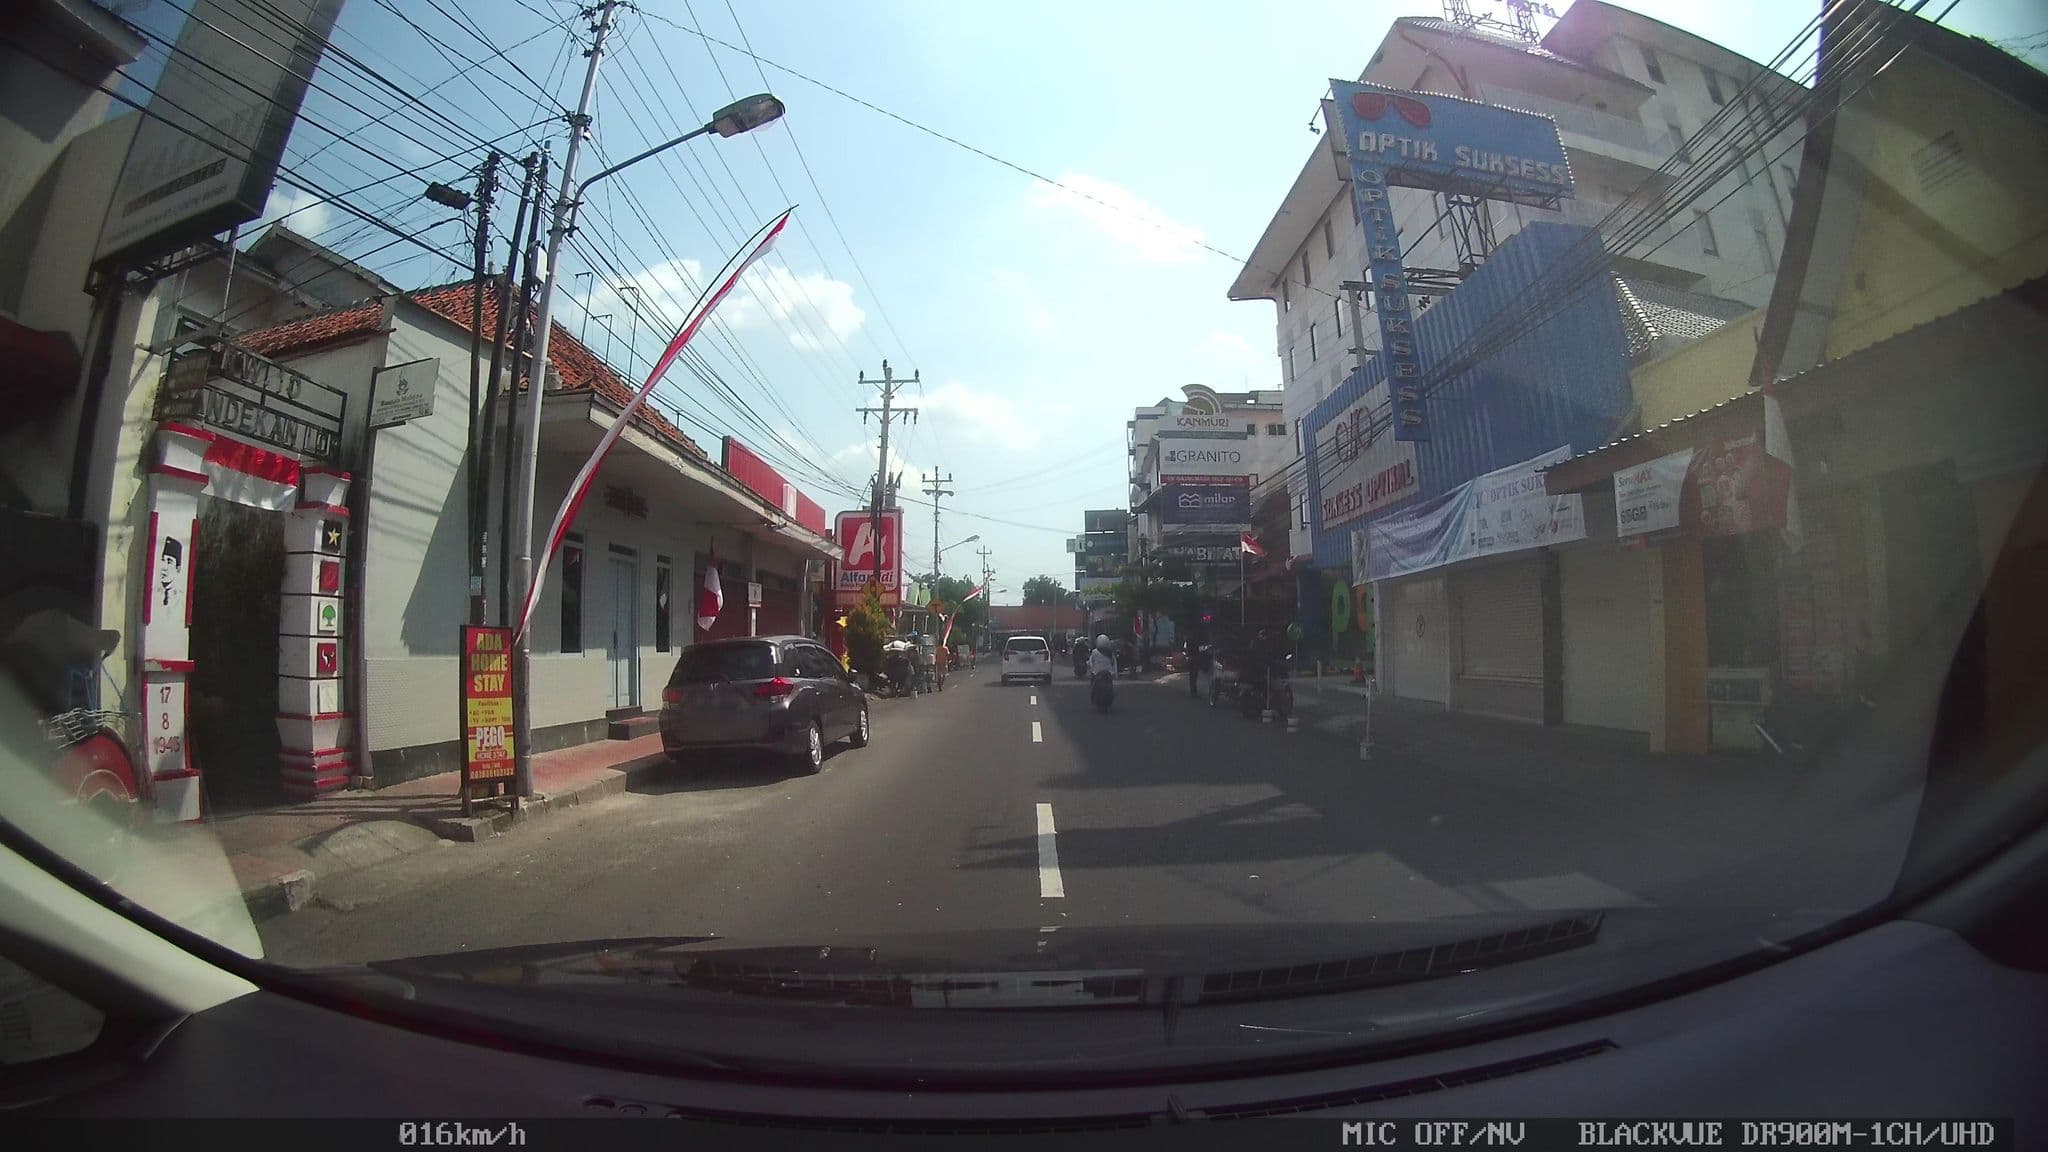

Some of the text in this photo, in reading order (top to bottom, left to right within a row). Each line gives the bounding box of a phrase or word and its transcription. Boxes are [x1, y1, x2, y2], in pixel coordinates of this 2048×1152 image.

[1359, 130, 1566, 185] OPTIK SUKSESS
[1176, 417, 1229, 428] KANMURI
[1176, 449, 1241, 463] GRANITO
[476, 632, 503, 651] ADA
[471, 653, 508, 672] HOME
[473, 673, 506, 692] STAY
[160, 686, 171, 704] 17
[162, 712, 170, 730] 8
[476, 725, 505, 748] PEGO
